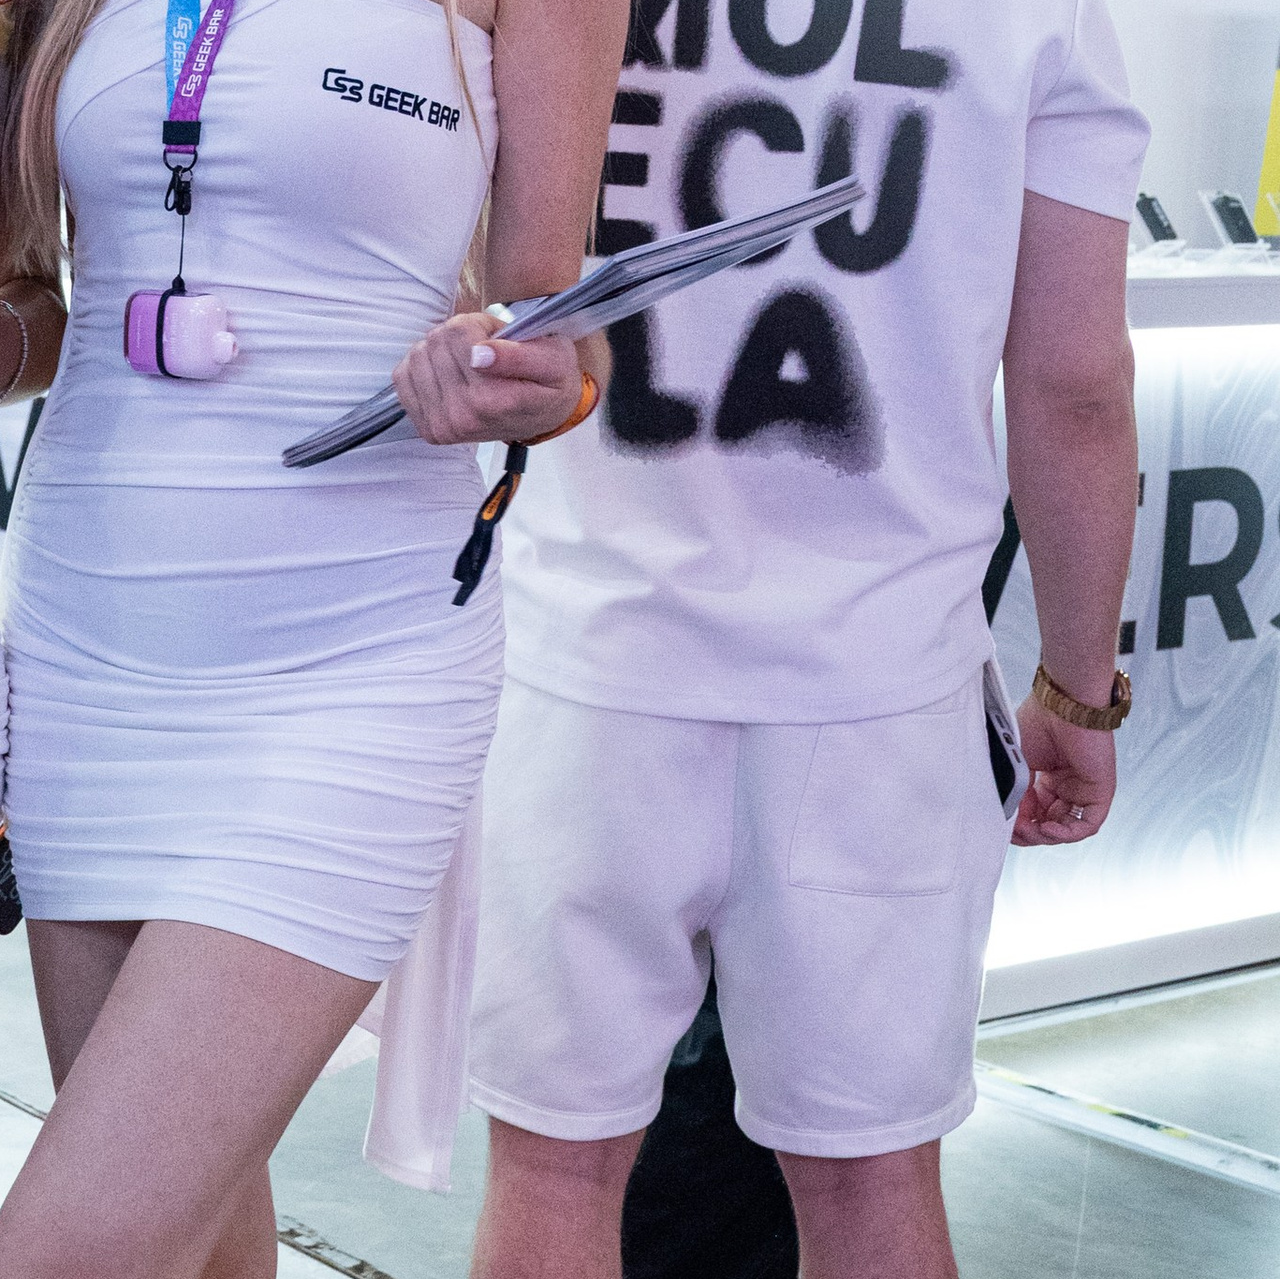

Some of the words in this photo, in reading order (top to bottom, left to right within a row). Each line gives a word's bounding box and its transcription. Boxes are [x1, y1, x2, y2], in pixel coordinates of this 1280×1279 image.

[192, 36, 215, 72] GEEK
[205, 8, 225, 35] BAR
[368, 83, 427, 121] GEEK
[427, 100, 460, 132] BAR
